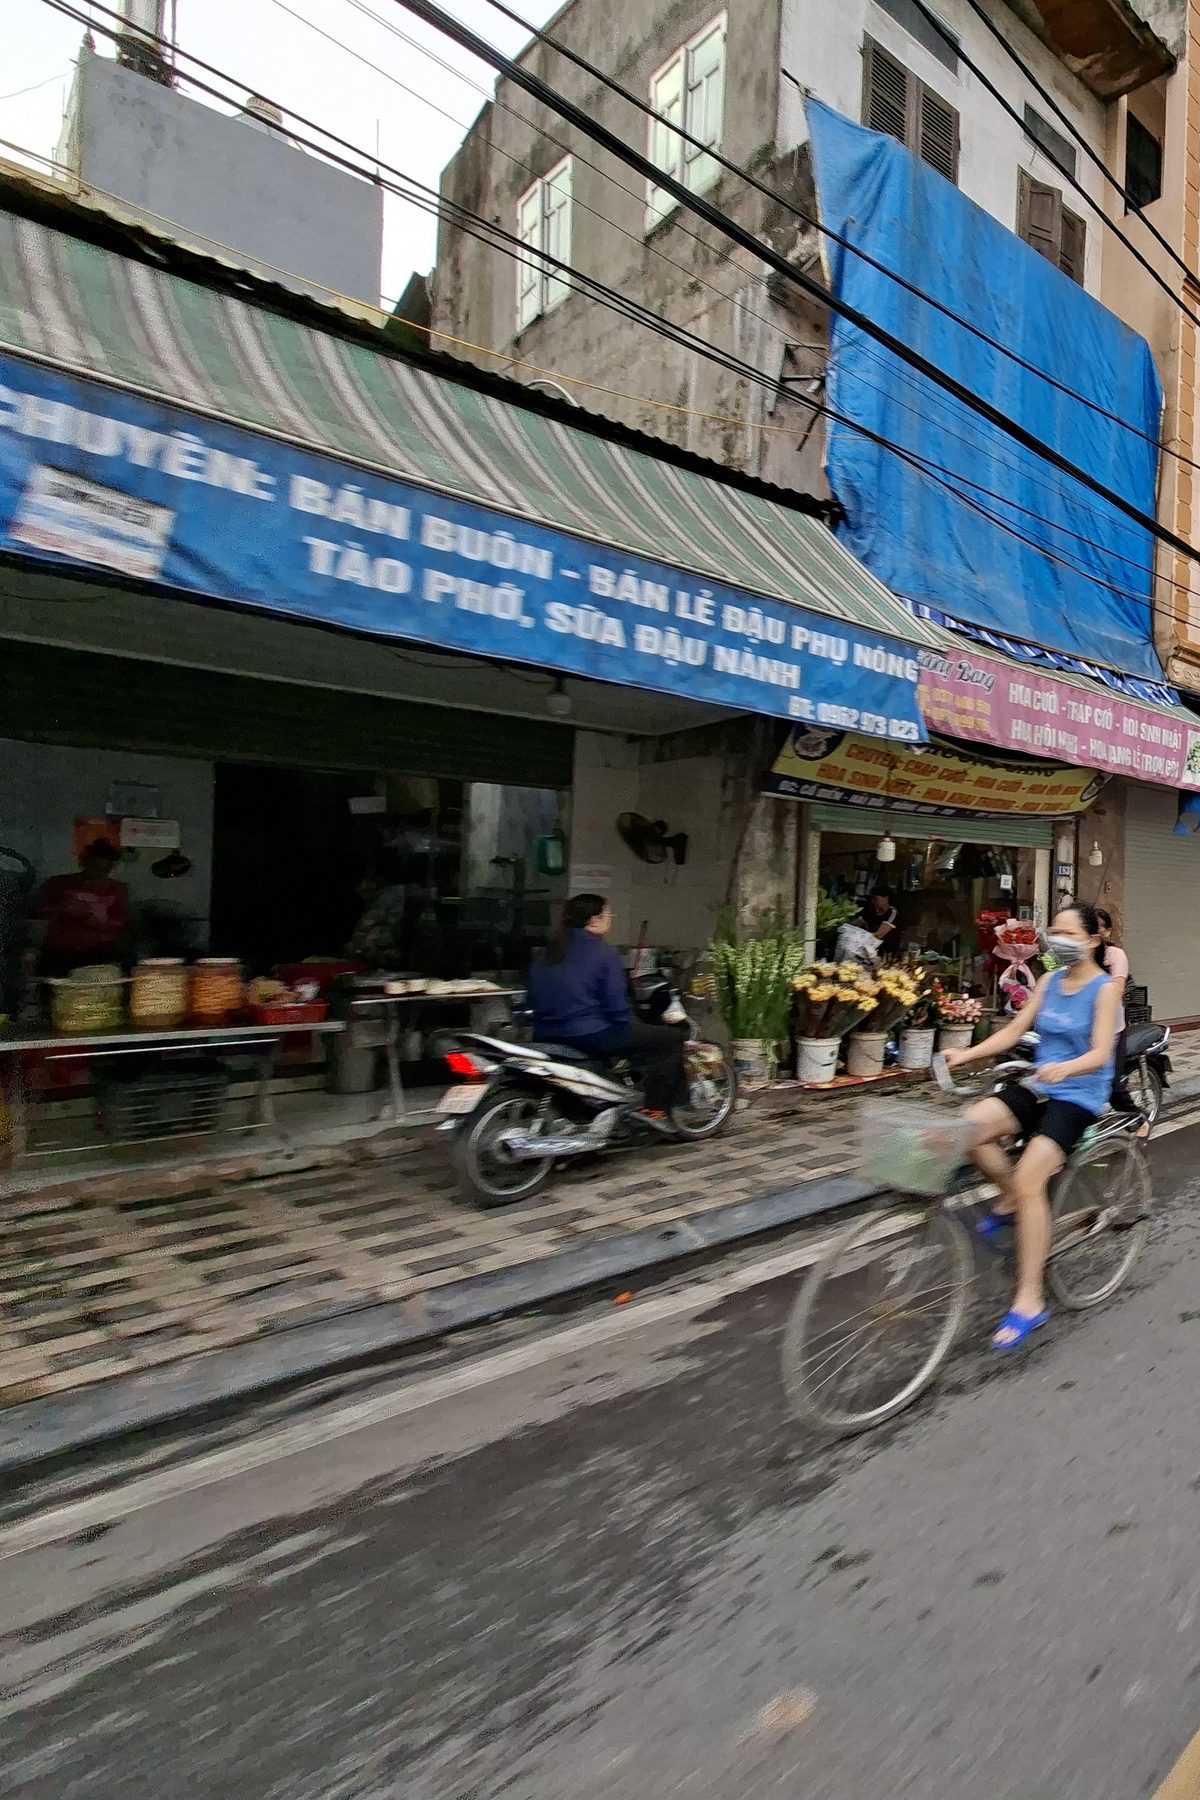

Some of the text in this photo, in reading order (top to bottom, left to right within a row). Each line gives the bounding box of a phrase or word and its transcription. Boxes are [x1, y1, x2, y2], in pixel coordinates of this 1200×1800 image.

[289, 474, 412, 540] BÁN
[420, 514, 553, 580] BUÔN
[589, 564, 669, 613] BÁN
[675, 589, 716, 626] LẺ
[722, 605, 786, 644] ĐẬU
[791, 625, 848, 666] PHỤ
[853, 642, 918, 683] NÓNG
[302, 536, 413, 593] TÀO
[544, 601, 627, 648] SỮA
[634, 624, 708, 666] ĐẬU
[713, 645, 800, 689] NÀNH
